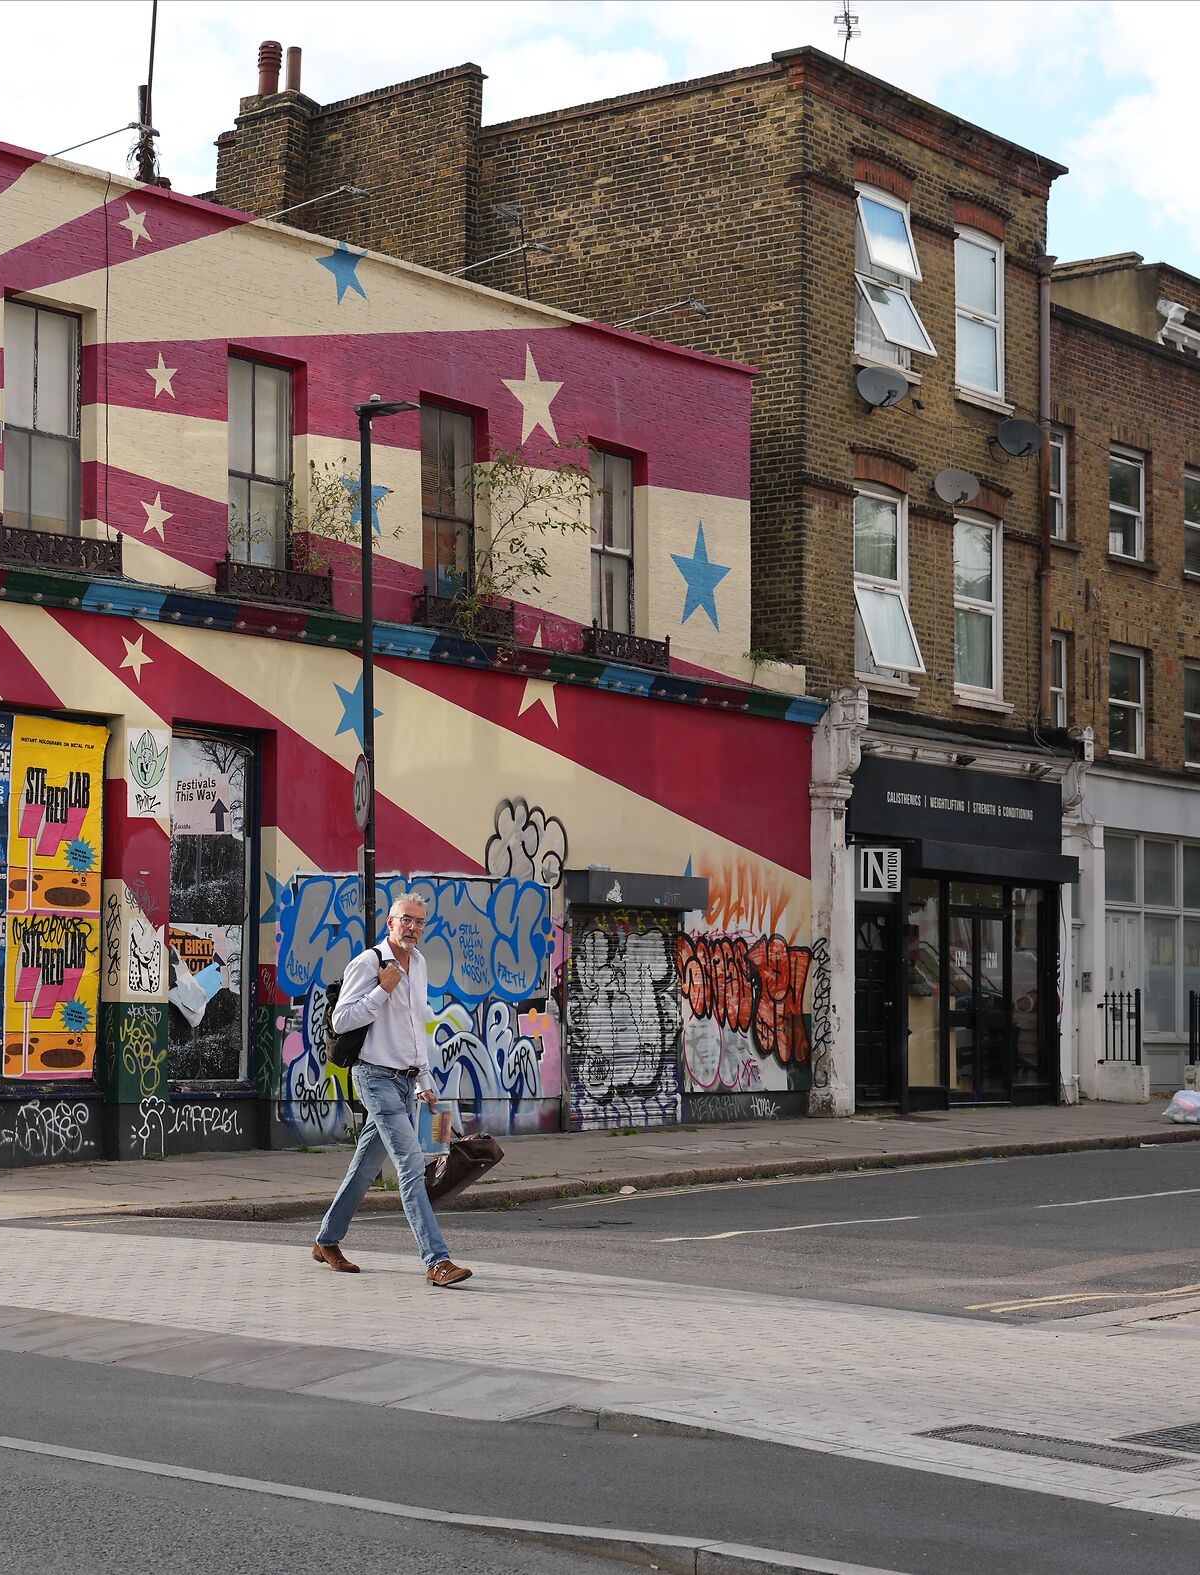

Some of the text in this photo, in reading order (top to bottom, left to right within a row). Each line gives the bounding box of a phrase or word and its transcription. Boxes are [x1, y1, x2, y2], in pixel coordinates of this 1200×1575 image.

[176, 789, 216, 802] This Way
[177, 778, 216, 790] Festivals
[355, 775, 367, 813] 20
[887, 791, 921, 806] CALISTHENICS
[929, 796, 965, 812] WEIGHTLIFTING
[972, 802, 996, 816] STRENGTH
[1002, 806, 1033, 820] CONDITIONING
[887, 851, 898, 889] MOTION
